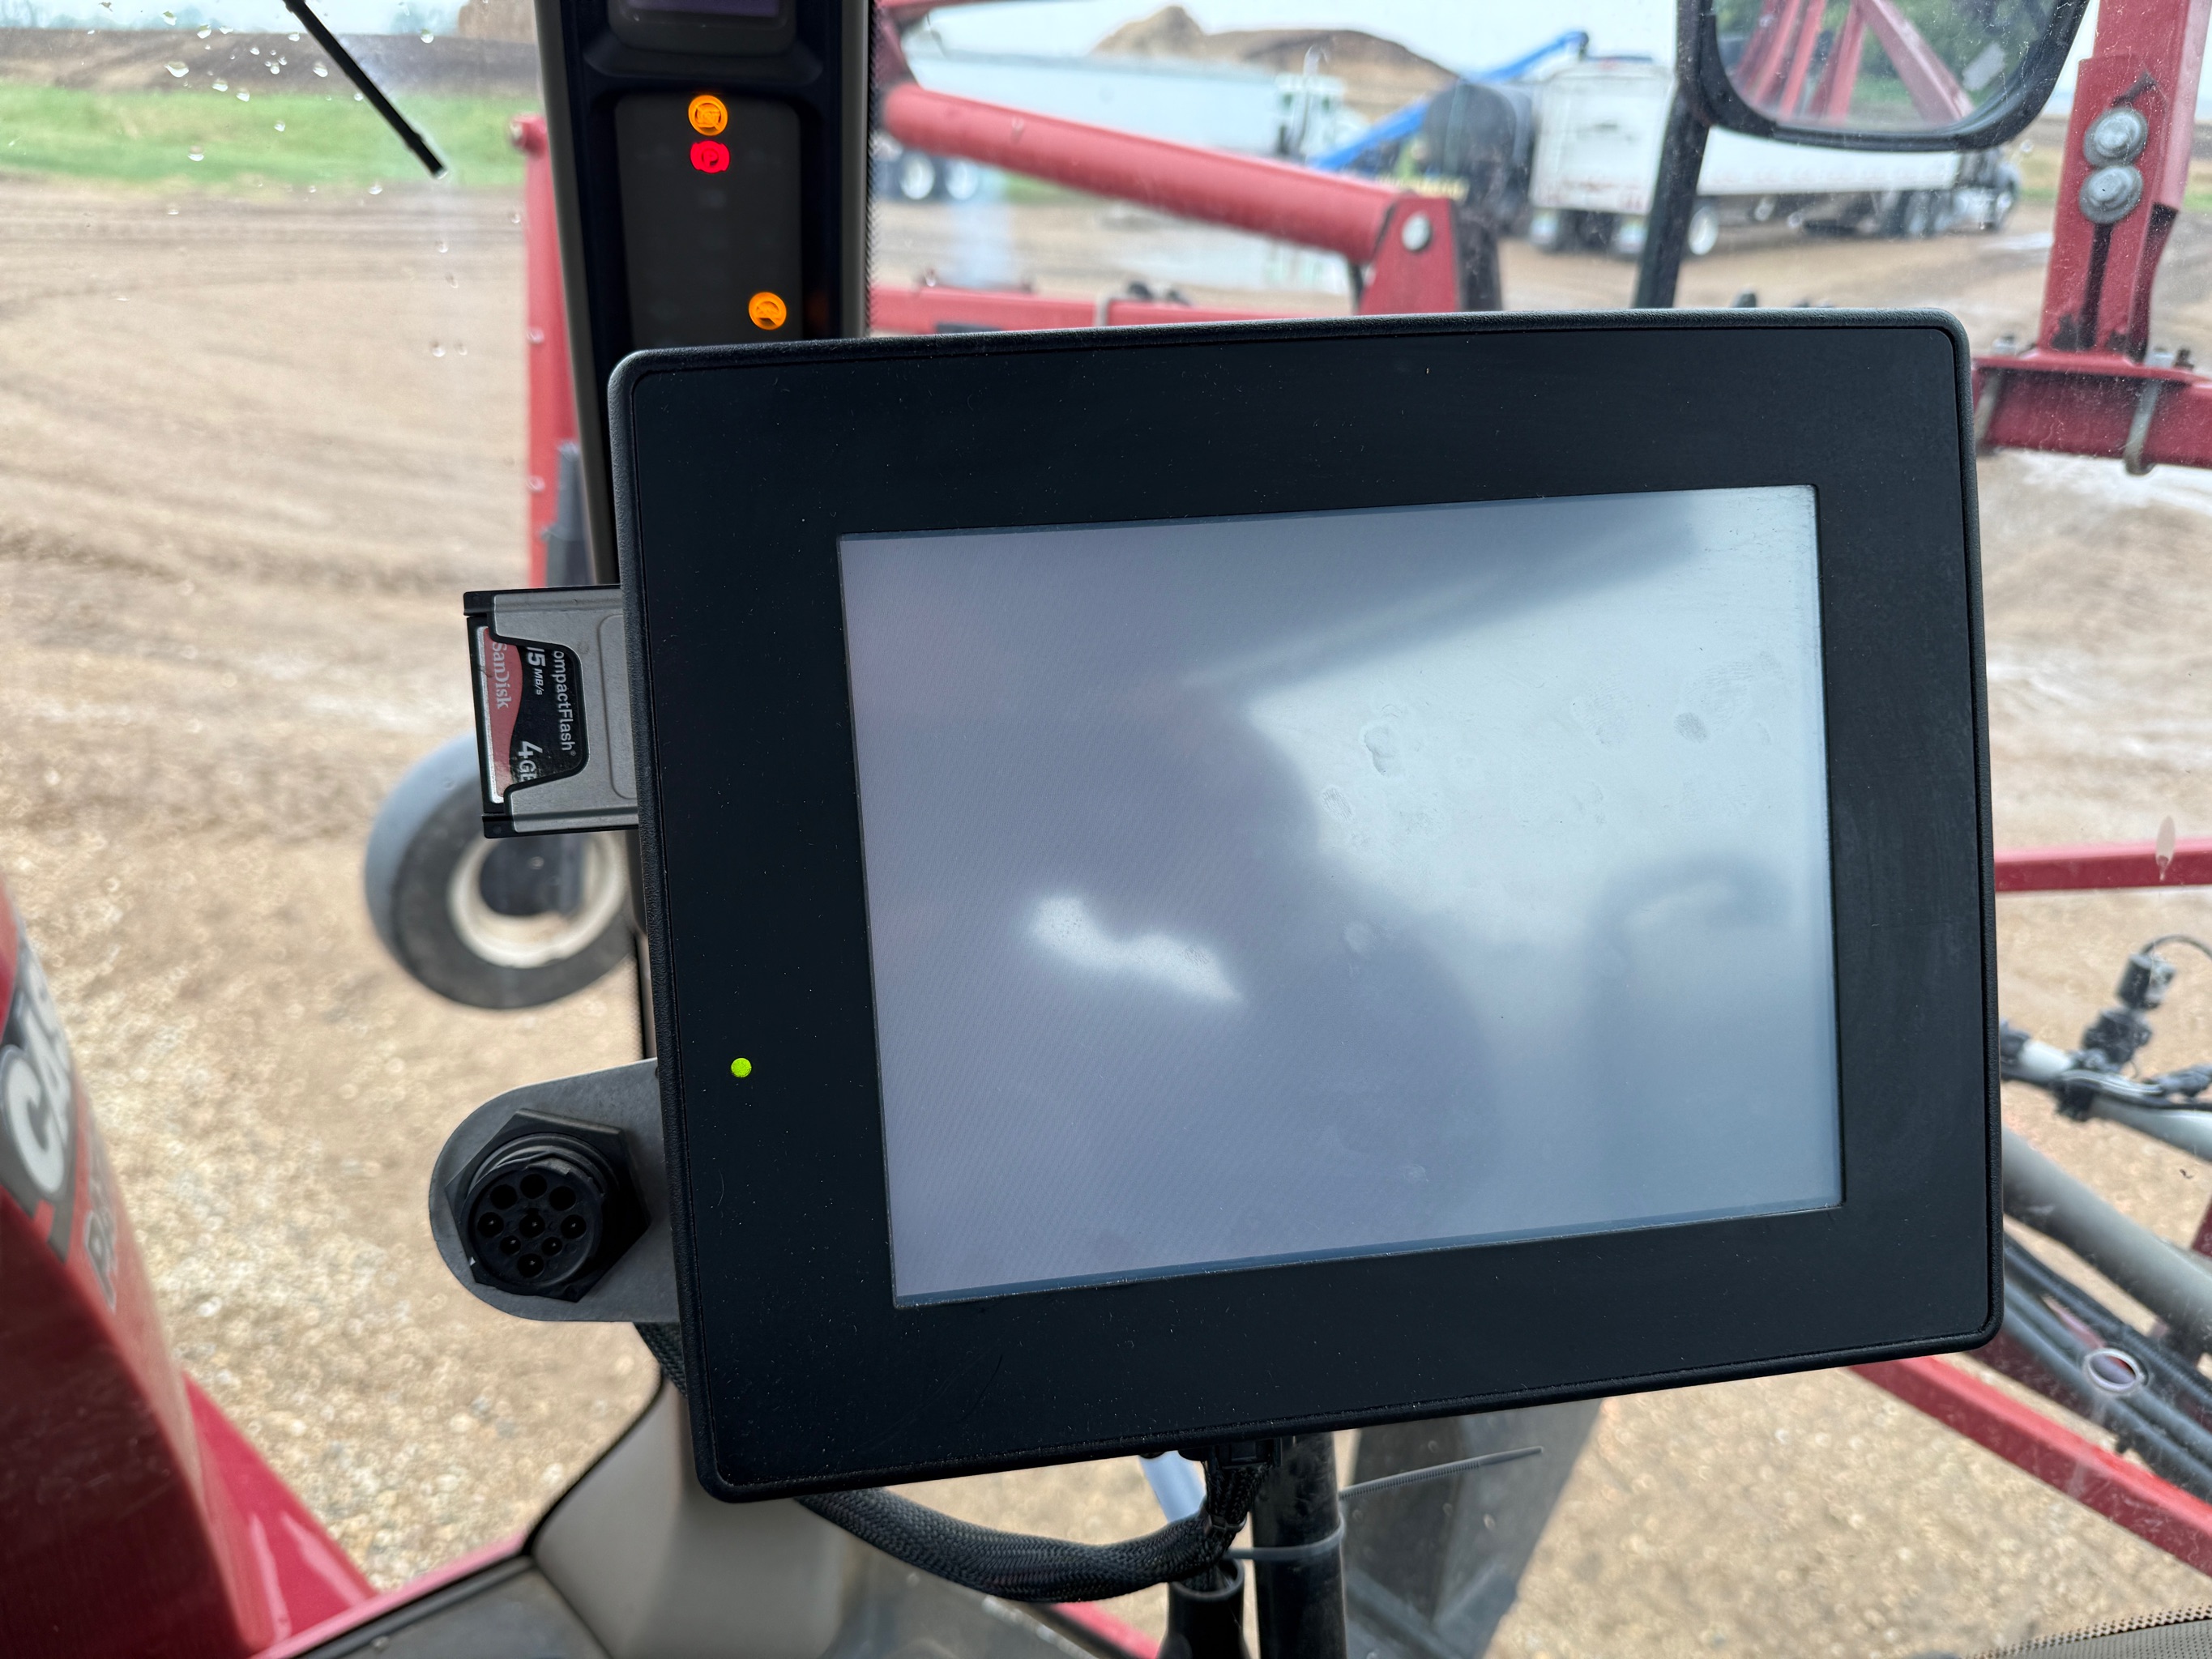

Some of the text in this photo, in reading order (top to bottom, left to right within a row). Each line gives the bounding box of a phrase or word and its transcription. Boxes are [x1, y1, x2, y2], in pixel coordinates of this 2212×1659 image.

[492, 642, 512, 710] SanDisk
[534, 668, 544, 696] MB/s
[551, 650, 574, 751] ompactFlash
